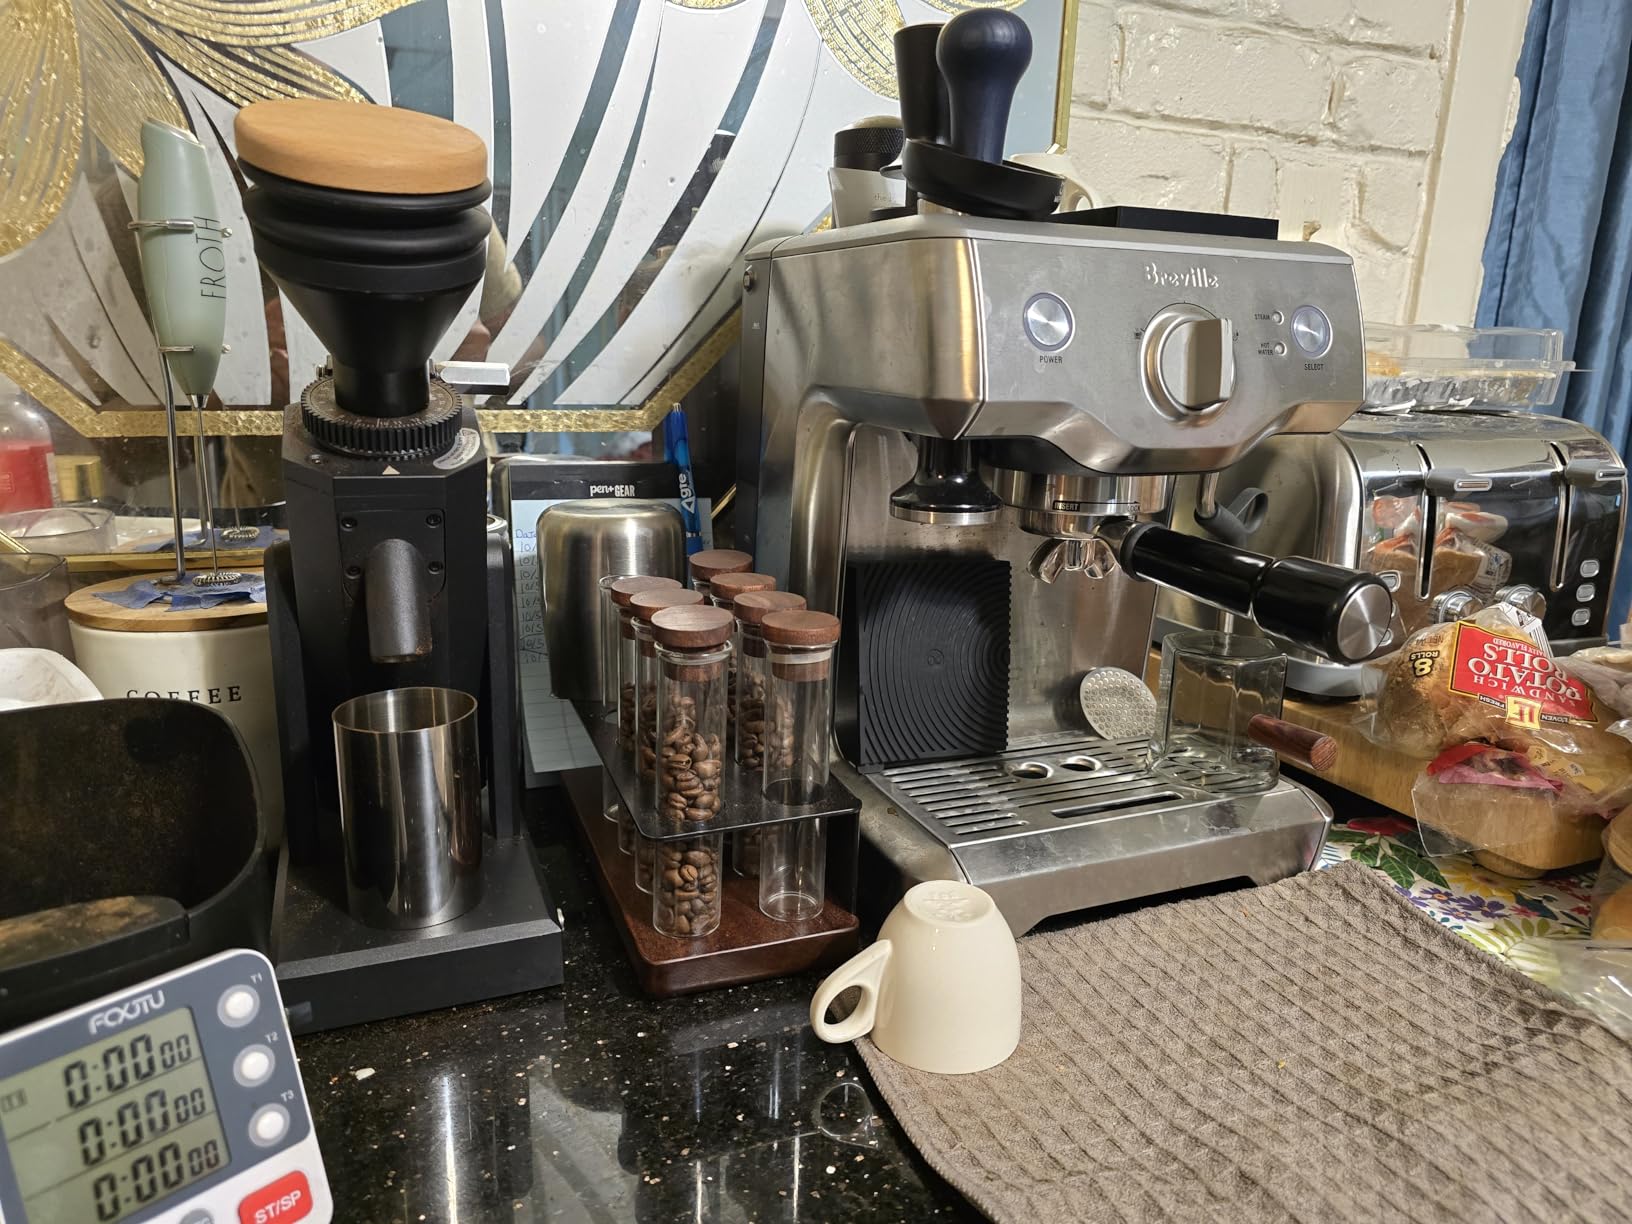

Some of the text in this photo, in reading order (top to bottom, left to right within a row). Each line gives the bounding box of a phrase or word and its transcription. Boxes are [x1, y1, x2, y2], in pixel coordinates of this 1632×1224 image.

[193, 216, 227, 299] FROTH
[1145, 262, 1219, 288] Breville
[1039, 355, 1063, 364] POWER
[1303, 363, 1325, 371] SELECT
[1054, 501, 1079, 511] INSERT
[1493, 637, 1528, 652] FLAVORED
[1410, 650, 1439, 660] ROLLS
[1483, 642, 1569, 683] ROLLS
[1412, 656, 1434, 678] 8
[1467, 657, 1582, 701] POTATO
[1479, 694, 1505, 709] FRESH
[250, 972, 263, 984] T1
[264, 1031, 279, 1044] T2
[280, 1089, 295, 1102] T3
[254, 1189, 302, 1224] ST/SP
